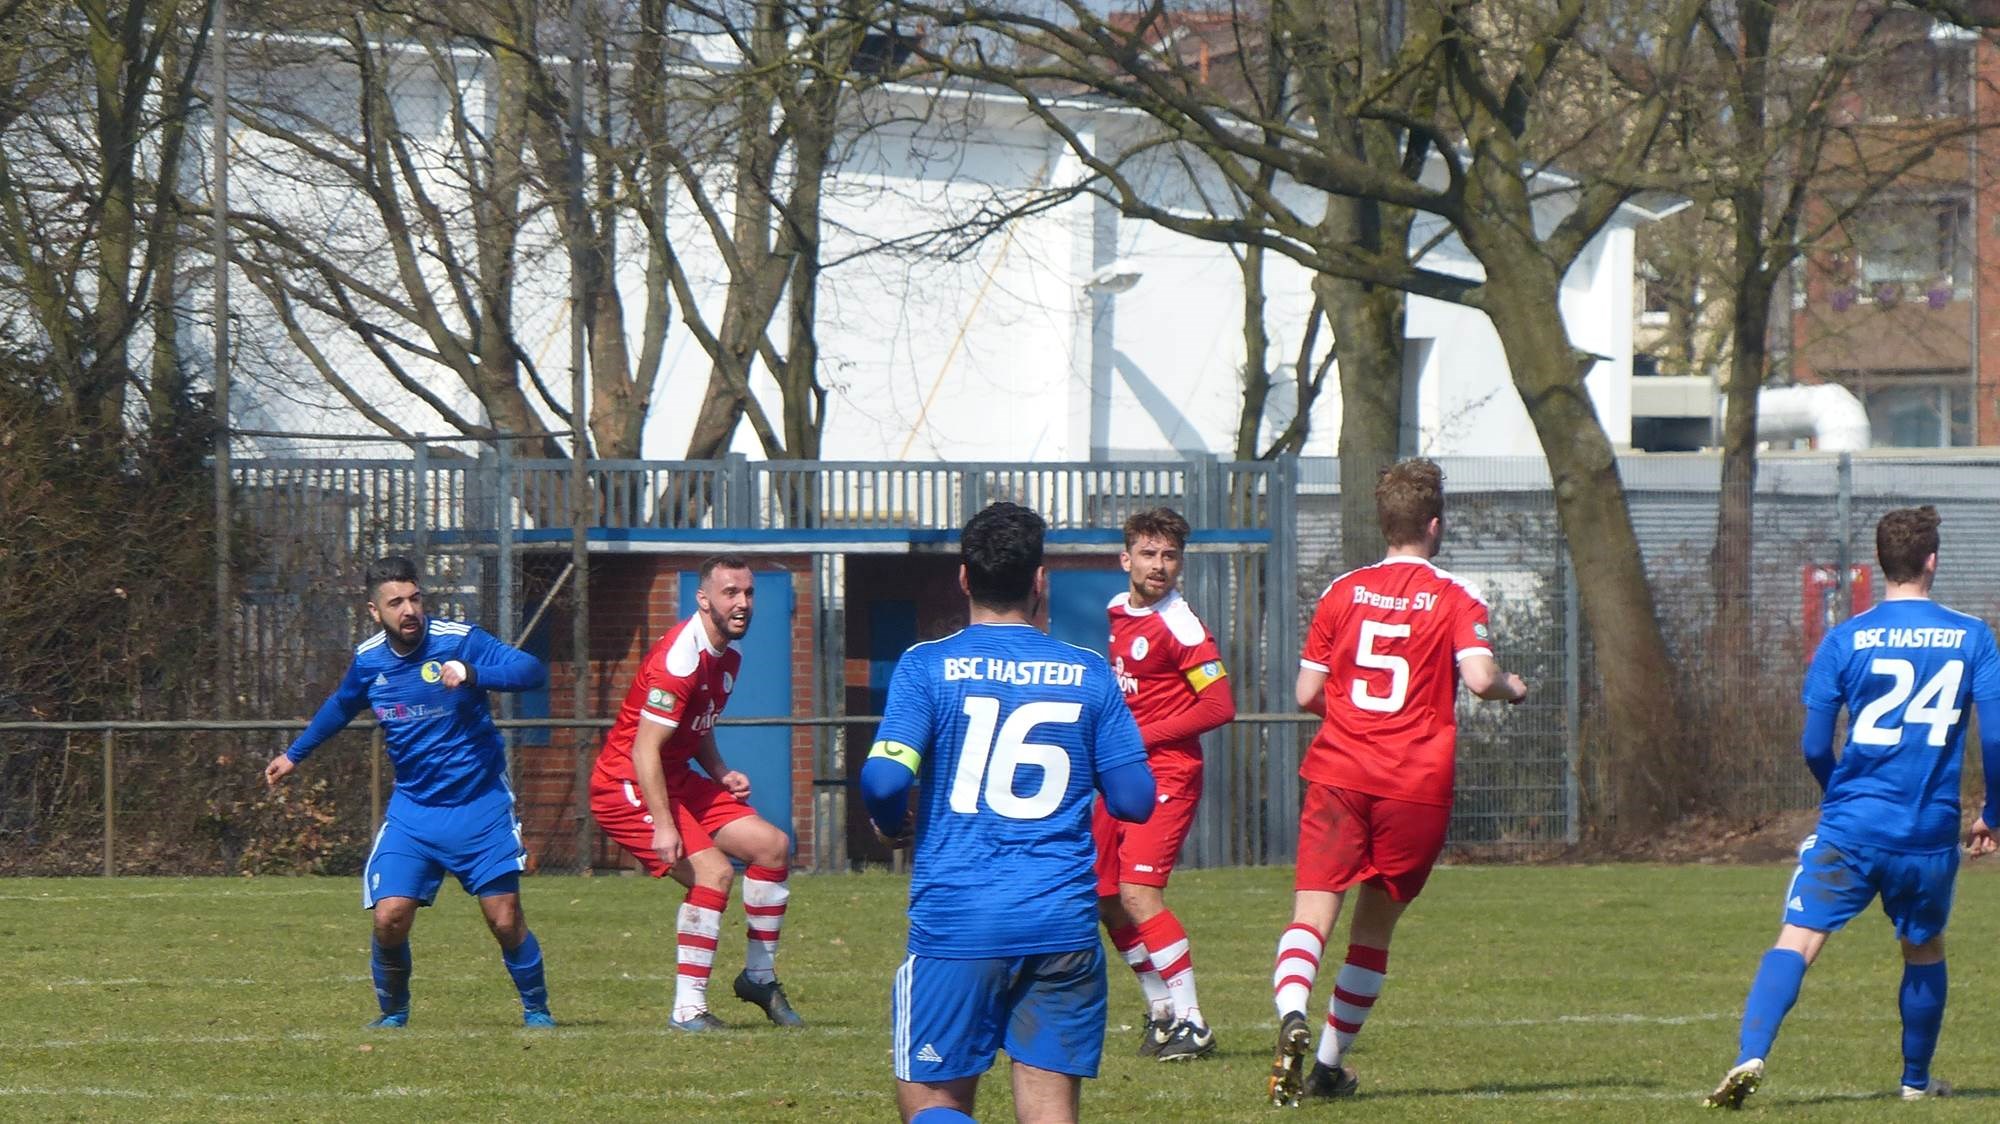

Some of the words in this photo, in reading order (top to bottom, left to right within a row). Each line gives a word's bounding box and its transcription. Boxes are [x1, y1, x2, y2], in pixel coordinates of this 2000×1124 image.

[1353, 585, 1409, 611] Bremer
[1412, 592, 1438, 611] SV
[1351, 619, 1411, 713] 5
[1853, 628, 1886, 650] BSC
[1887, 628, 1967, 649] HASTEDT
[944, 657, 984, 681] BSC
[987, 658, 1087, 687] HASTEDT
[1852, 658, 1964, 746] 24
[950, 696, 1083, 820] 16
